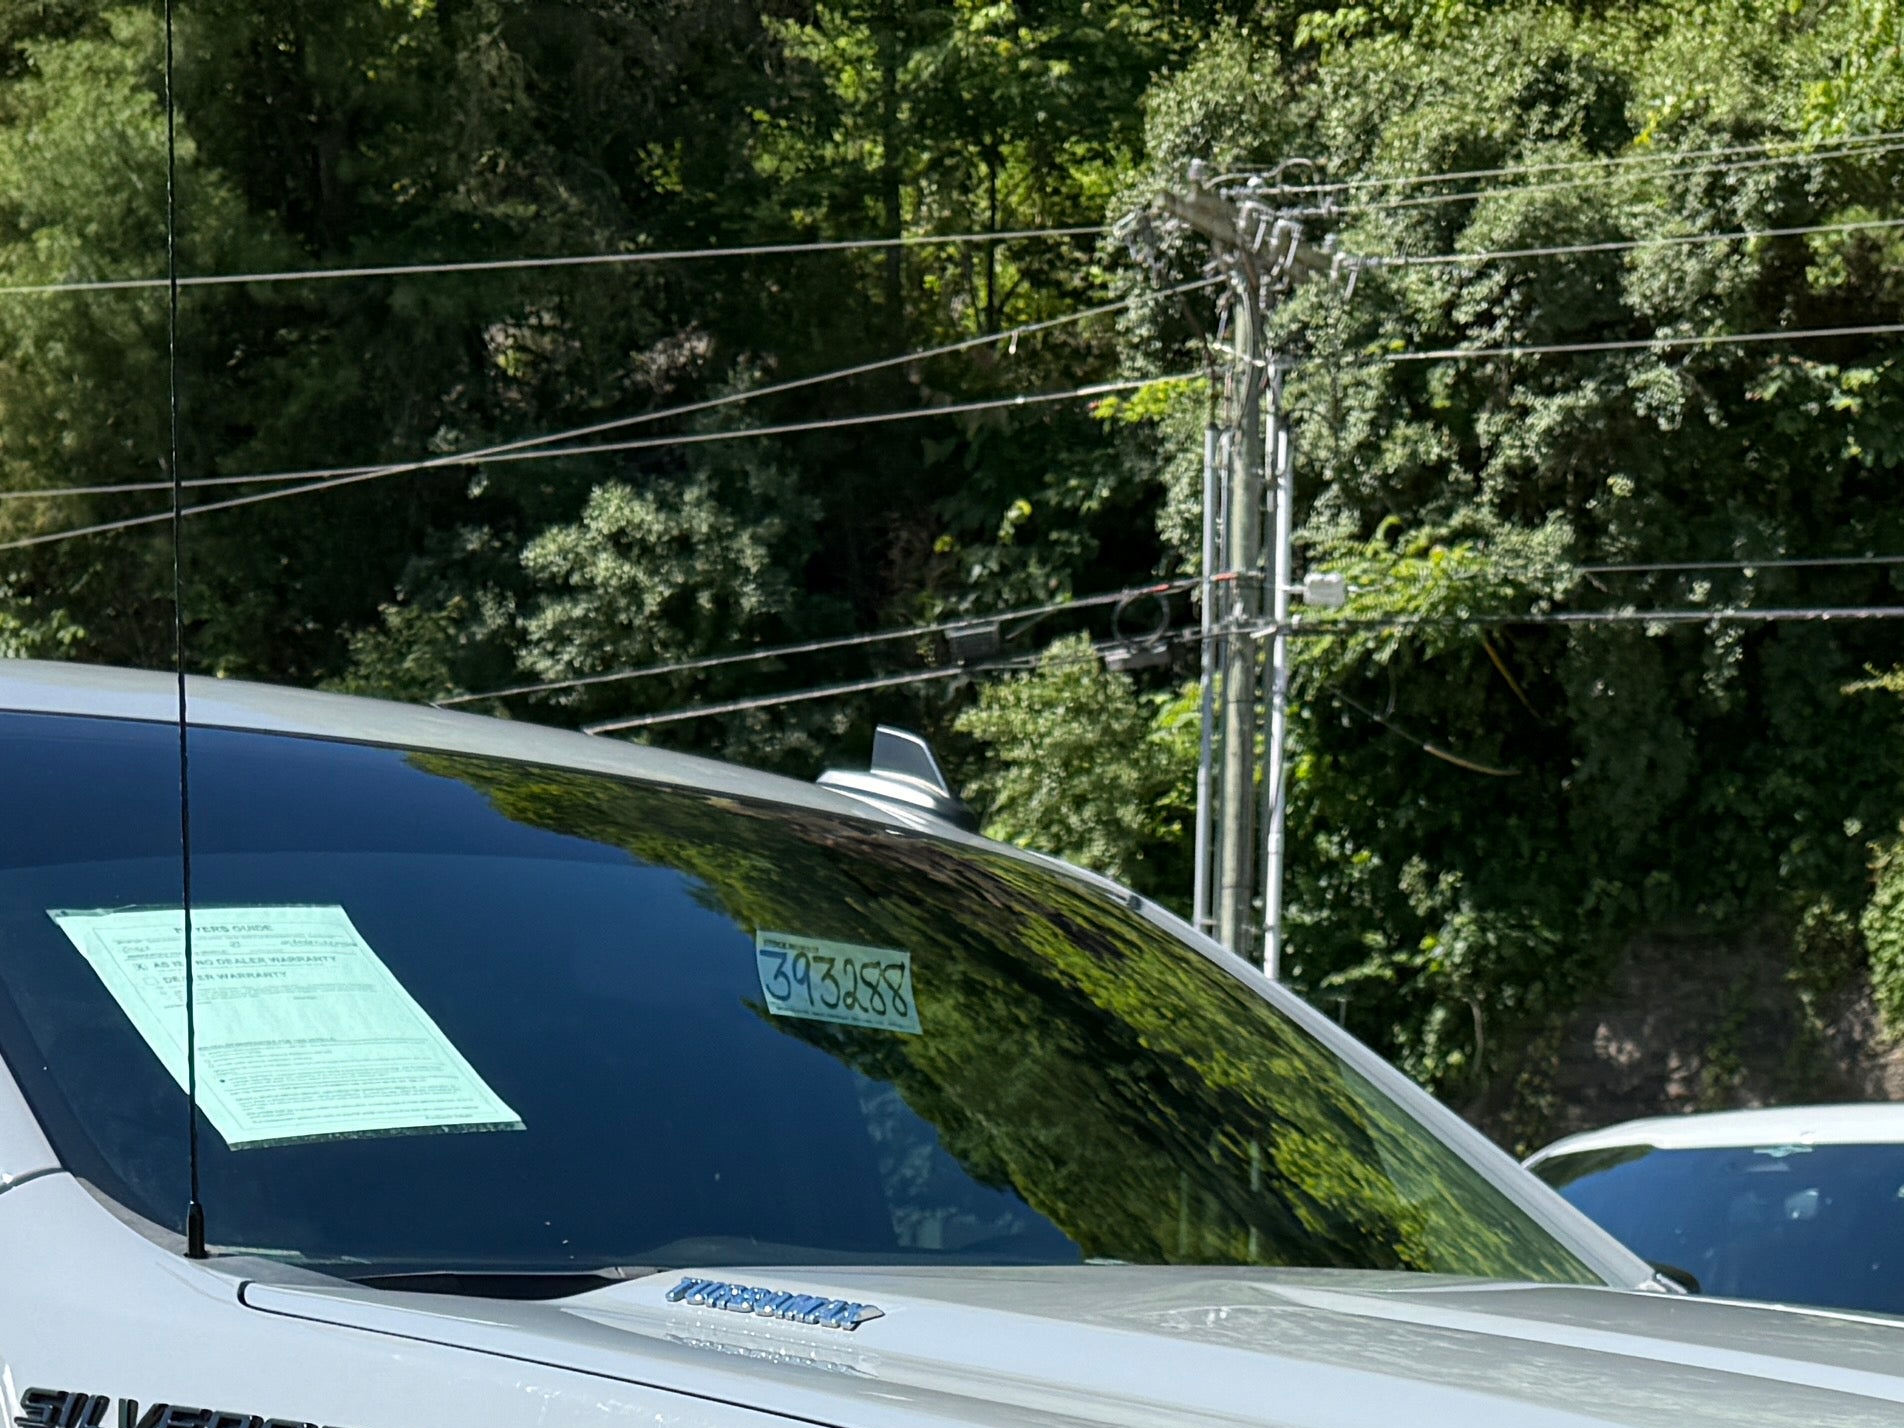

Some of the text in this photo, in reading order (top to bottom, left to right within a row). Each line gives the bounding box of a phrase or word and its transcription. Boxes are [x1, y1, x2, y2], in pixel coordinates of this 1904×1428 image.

[215, 956, 266, 966] DEALER
[268, 955, 337, 964] WARRANTY
[216, 971, 287, 981] WARRANTY
[759, 949, 908, 1018] 393288
